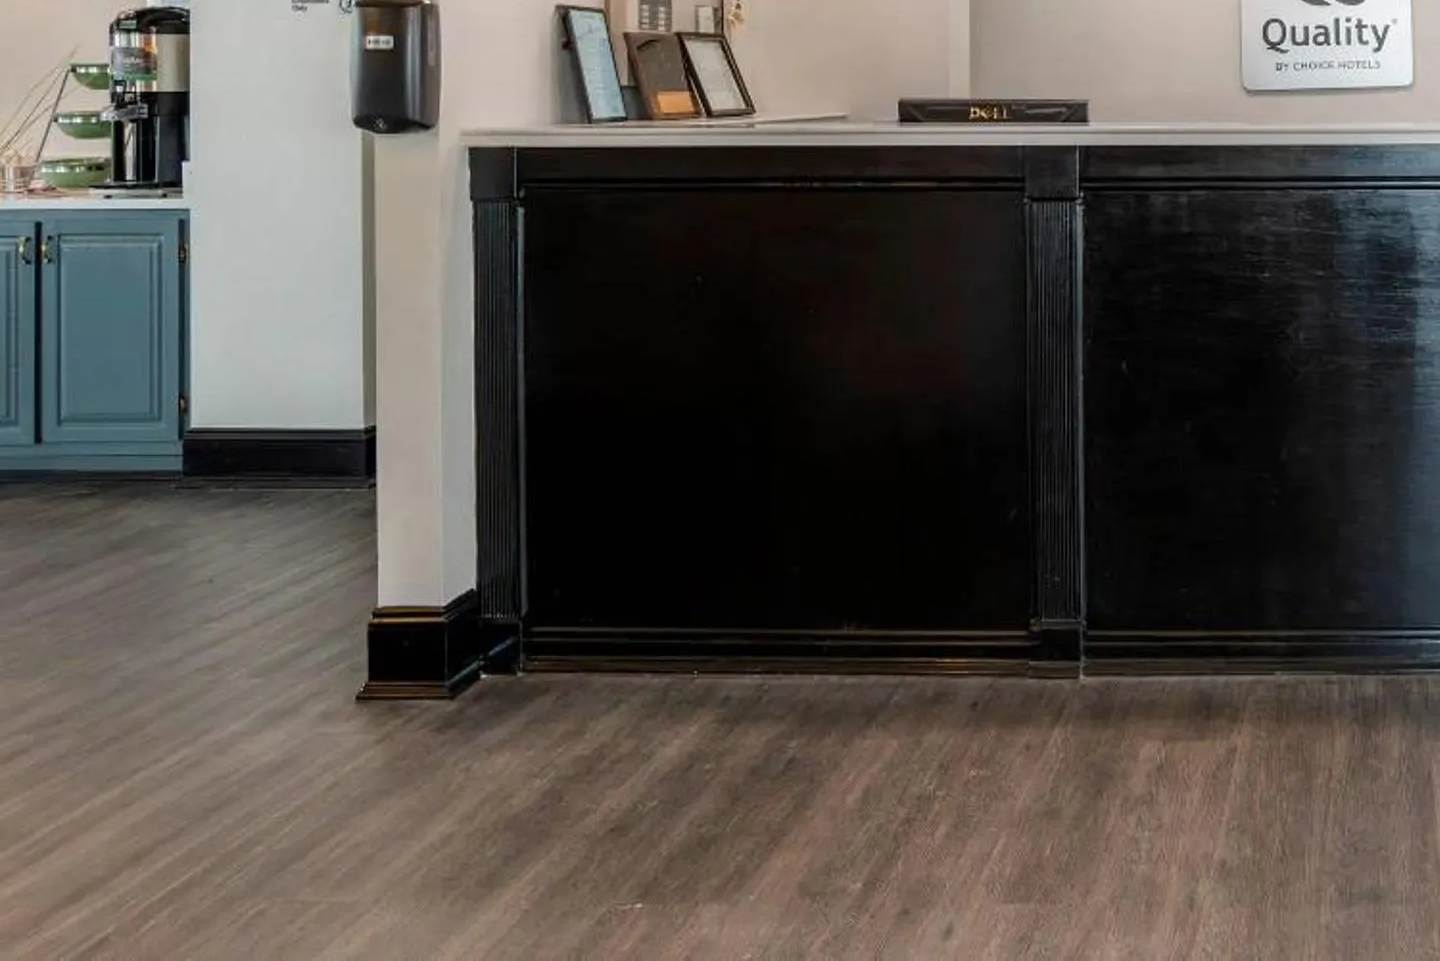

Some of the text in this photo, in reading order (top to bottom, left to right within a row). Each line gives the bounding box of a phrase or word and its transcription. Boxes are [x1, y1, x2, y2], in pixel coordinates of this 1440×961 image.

[1262, 17, 1392, 54] Quality
[1293, 59, 1335, 71] CHOICE
[1337, 58, 1381, 70] HOTELS
